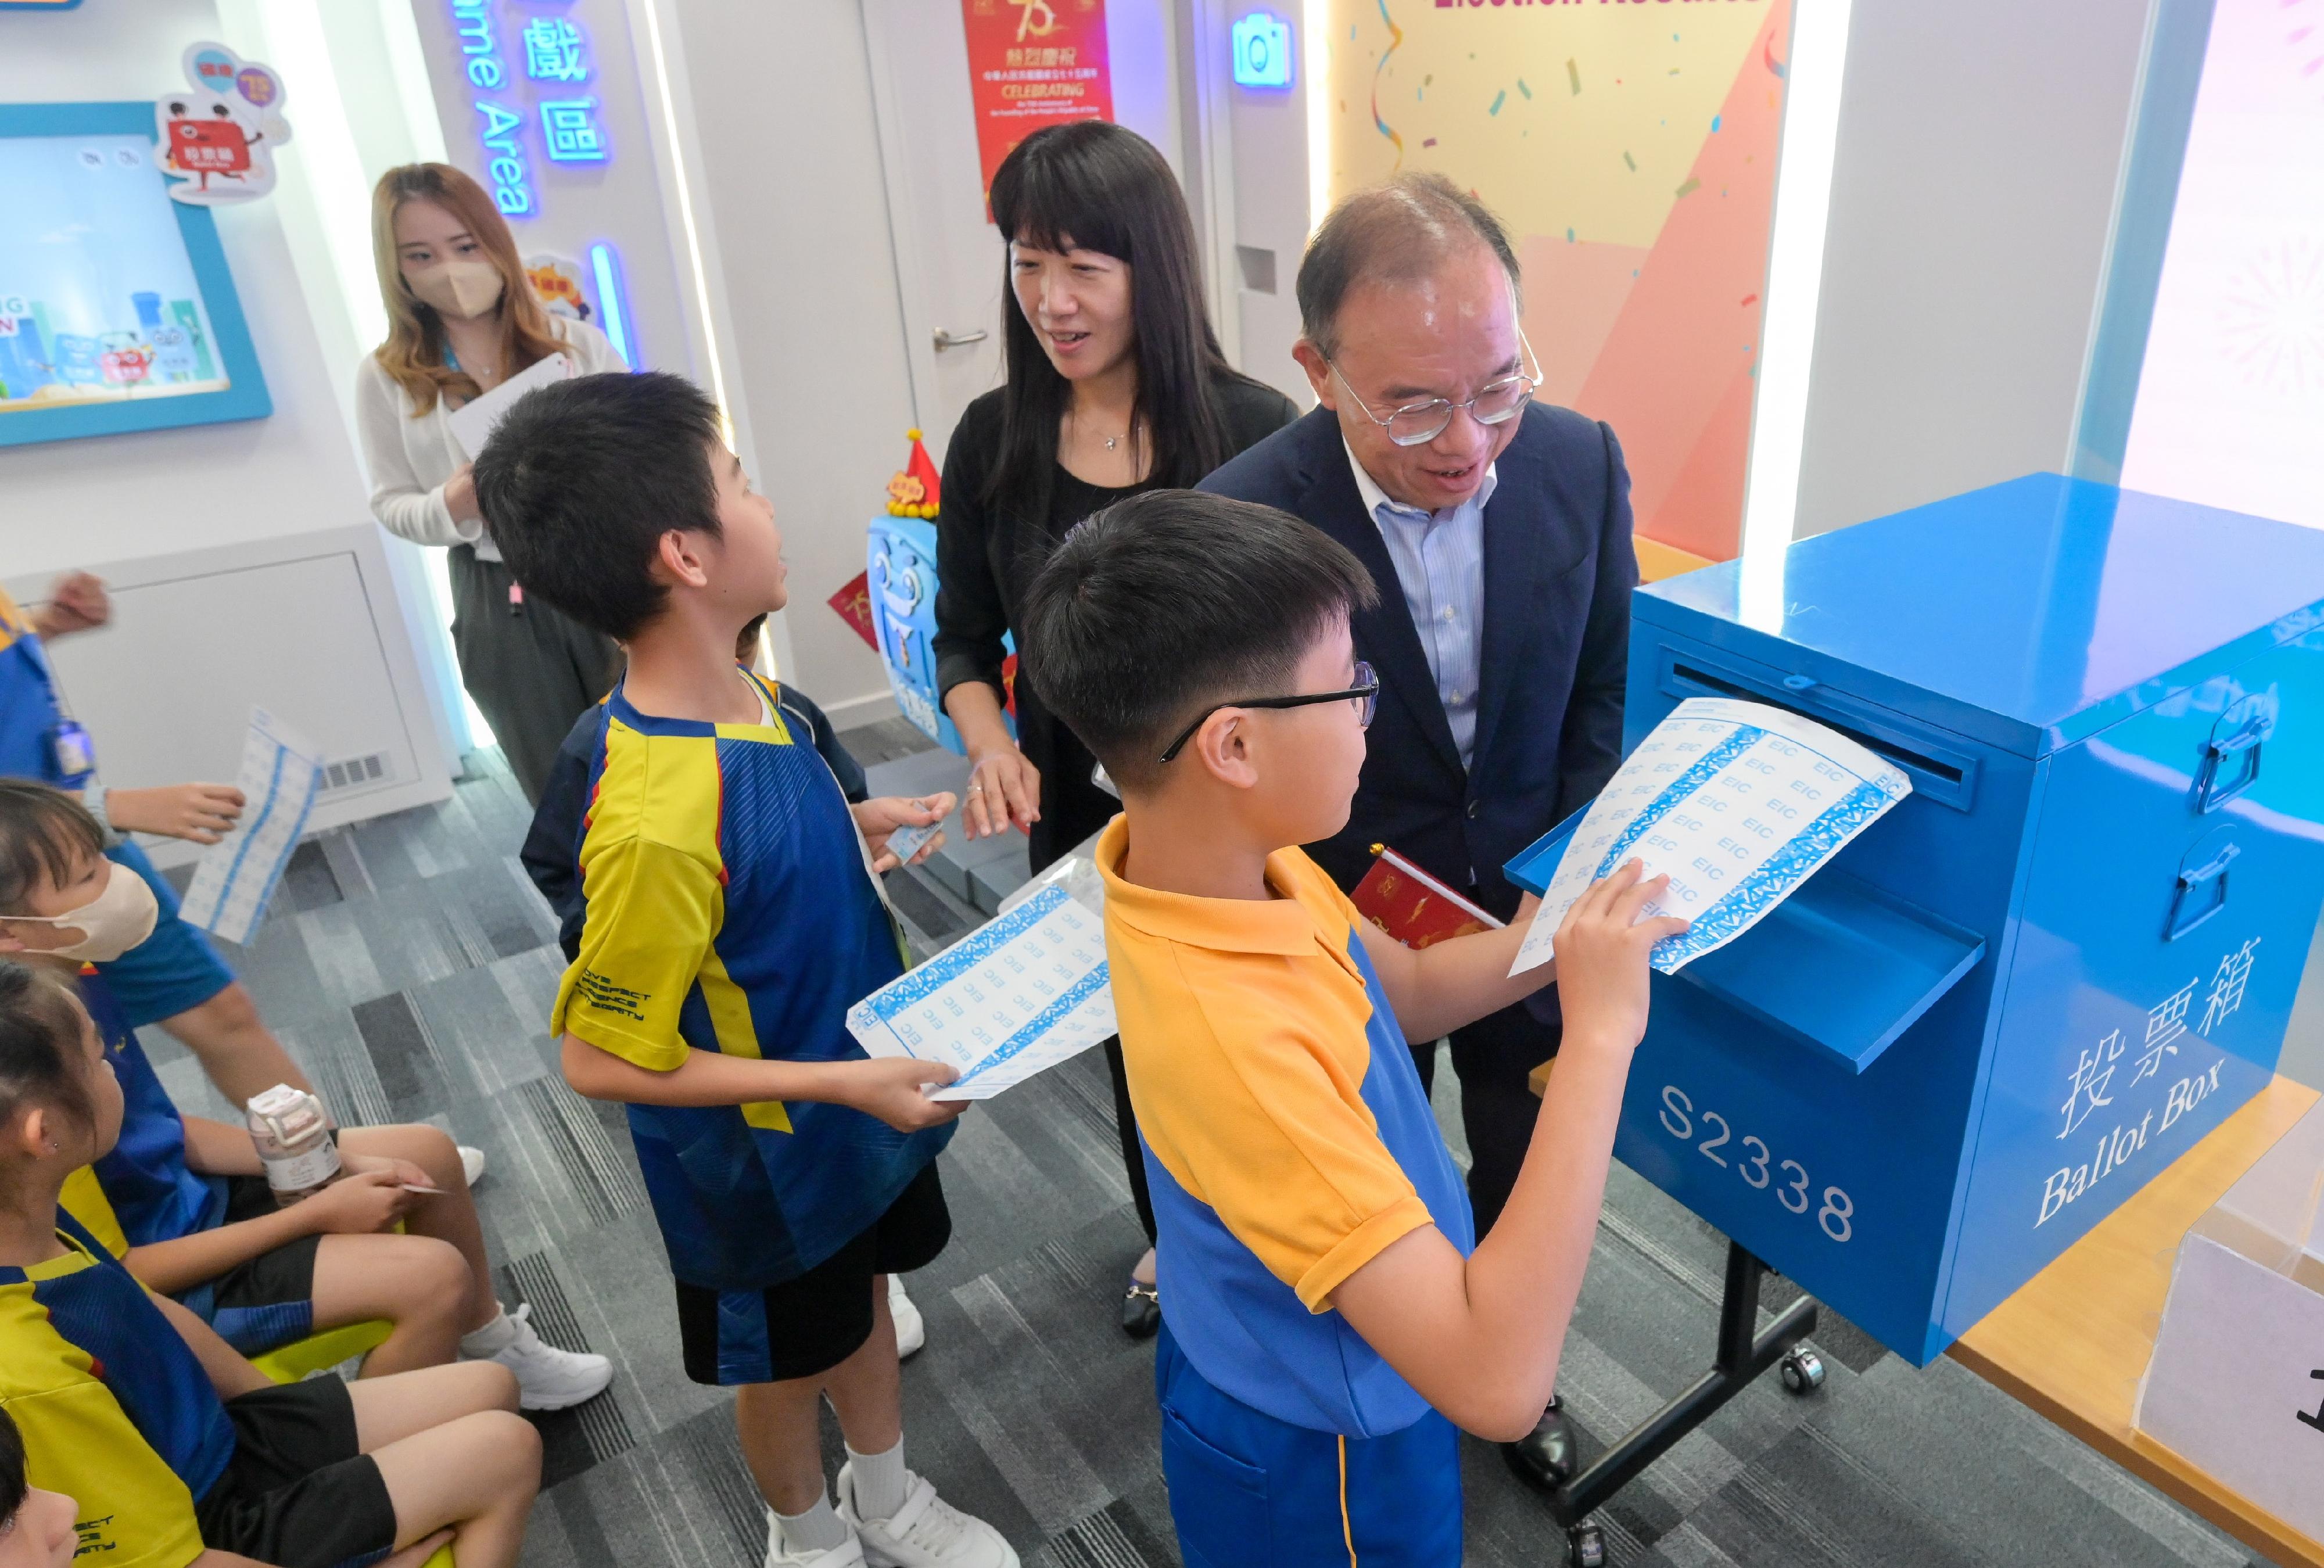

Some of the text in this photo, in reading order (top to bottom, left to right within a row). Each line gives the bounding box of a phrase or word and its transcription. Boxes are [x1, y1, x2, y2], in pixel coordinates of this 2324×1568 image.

[1001, 83, 1084, 99] CELEBRATING
[476, 102, 529, 214] Area
[1698, 723, 1725, 733] EIC
[1768, 741, 1798, 756] EIC
[1745, 758, 1776, 774] EIC
[1813, 762, 1844, 781] EIC
[1722, 777, 1752, 793] EIC
[1789, 780, 1821, 800] EIC
[1697, 795, 1727, 812] EIC
[1766, 799, 1798, 819] EIC
[1672, 815, 1703, 831] EIC
[1742, 817, 1774, 839] EIC
[1647, 835, 1677, 851] EIC
[1717, 837, 1749, 859] EIC
[1692, 857, 1724, 880] EIC
[1062, 914, 1083, 930] EIC
[1043, 928, 1064, 943] EIC
[1024, 942, 1045, 959] EIC
[1072, 949, 1093, 964] EIC
[1004, 956, 1025, 974] EIC
[1053, 964, 1074, 980] EIC
[984, 970, 1005, 988] EIC
[1033, 979, 1055, 995] EIC
[964, 983, 985, 1003] EIC
[944, 996, 964, 1017] EIC
[1013, 995, 1035, 1012] EIC
[923, 1009, 944, 1030] EIC
[992, 1011, 1014, 1028] EIC
[901, 1023, 923, 1046] EIC
[972, 1027, 993, 1046] EIC
[2057, 937, 2261, 1140] 投票箱
[951, 1040, 972, 1061] EIC
[2033, 1059, 2226, 1229] Ballot Box
[1659, 1085, 1853, 1242] S2338
